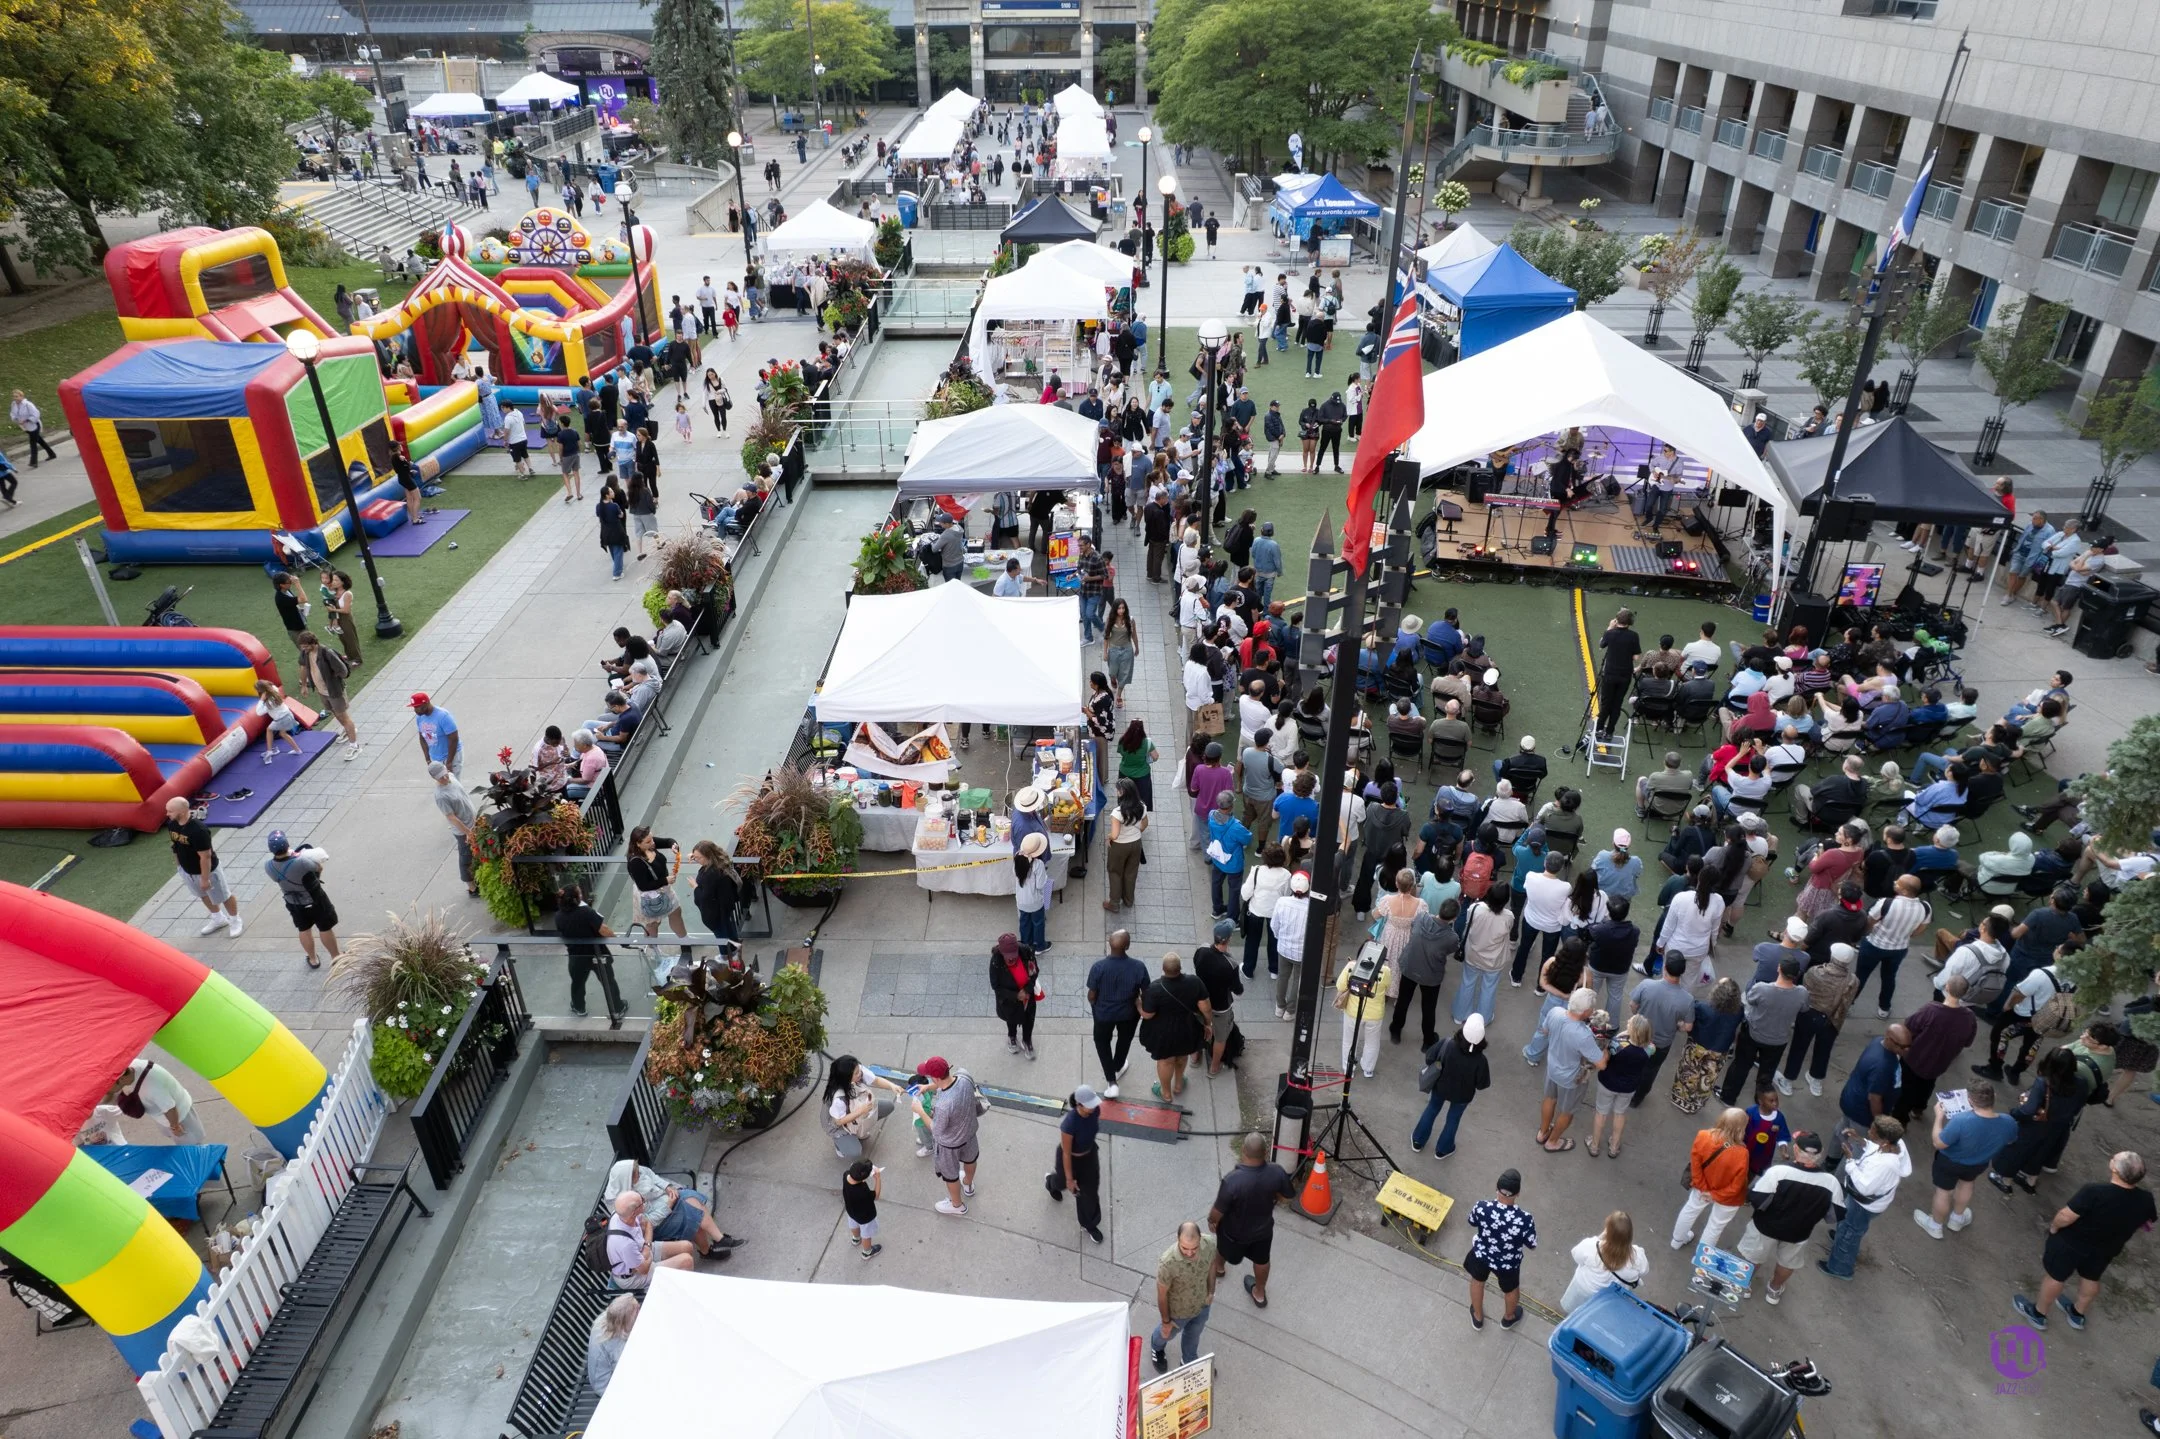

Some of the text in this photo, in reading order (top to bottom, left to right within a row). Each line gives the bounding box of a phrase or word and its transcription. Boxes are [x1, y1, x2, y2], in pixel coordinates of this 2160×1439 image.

[1325, 198, 1356, 207] Toronto
[1306, 208, 1369, 216] www.toronto.ca/water
[943, 861, 973, 870] CAUTION
[979, 856, 1008, 865] CAUTION
[1392, 1186, 1440, 1214] XTREME BOX
